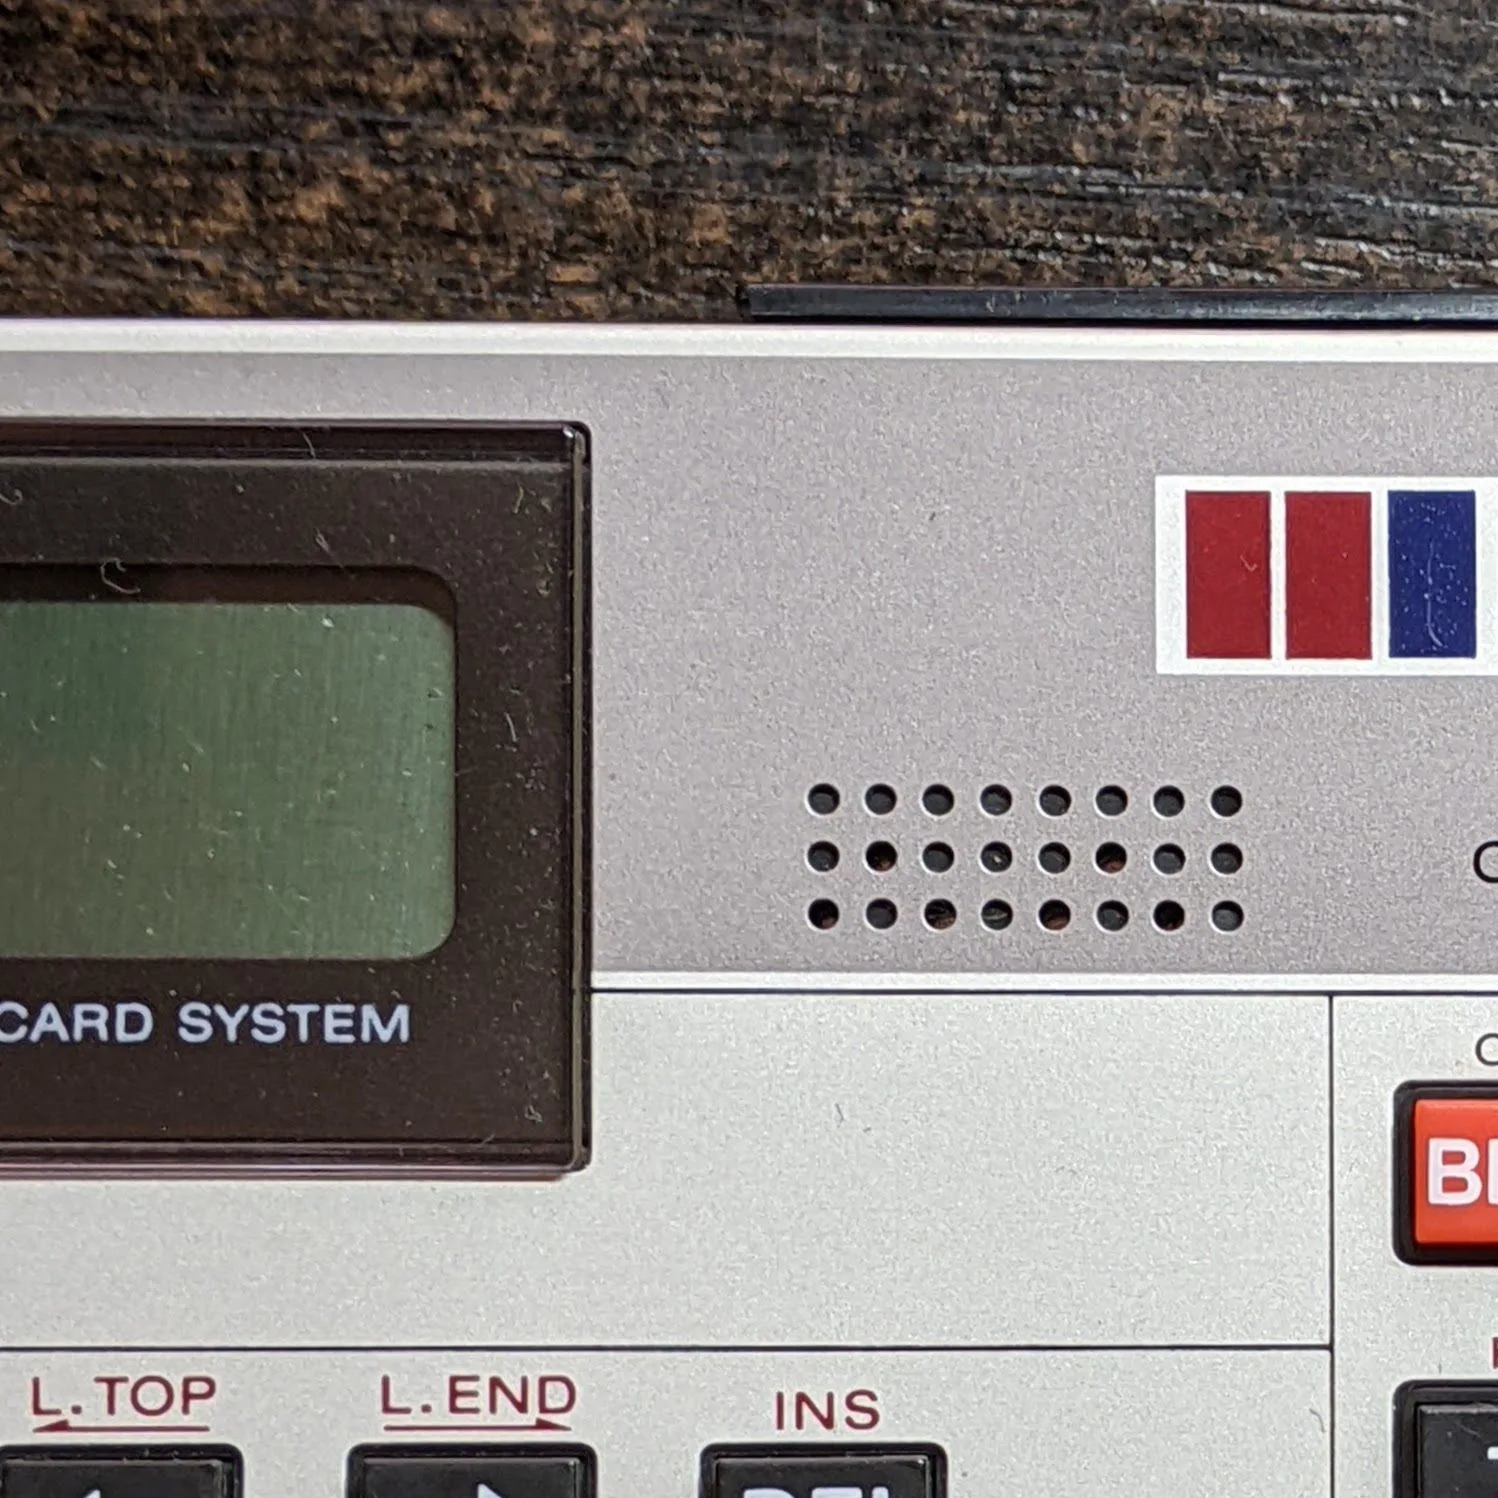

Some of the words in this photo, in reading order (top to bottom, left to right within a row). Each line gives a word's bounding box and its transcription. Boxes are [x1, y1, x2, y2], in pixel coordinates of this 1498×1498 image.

[0, 1001, 153, 1043] CARD
[178, 1002, 410, 1044] SYSTEM
[32, 1375, 217, 1416] L.TOP
[381, 1375, 577, 1415] L.END
[776, 1389, 881, 1431] INS
